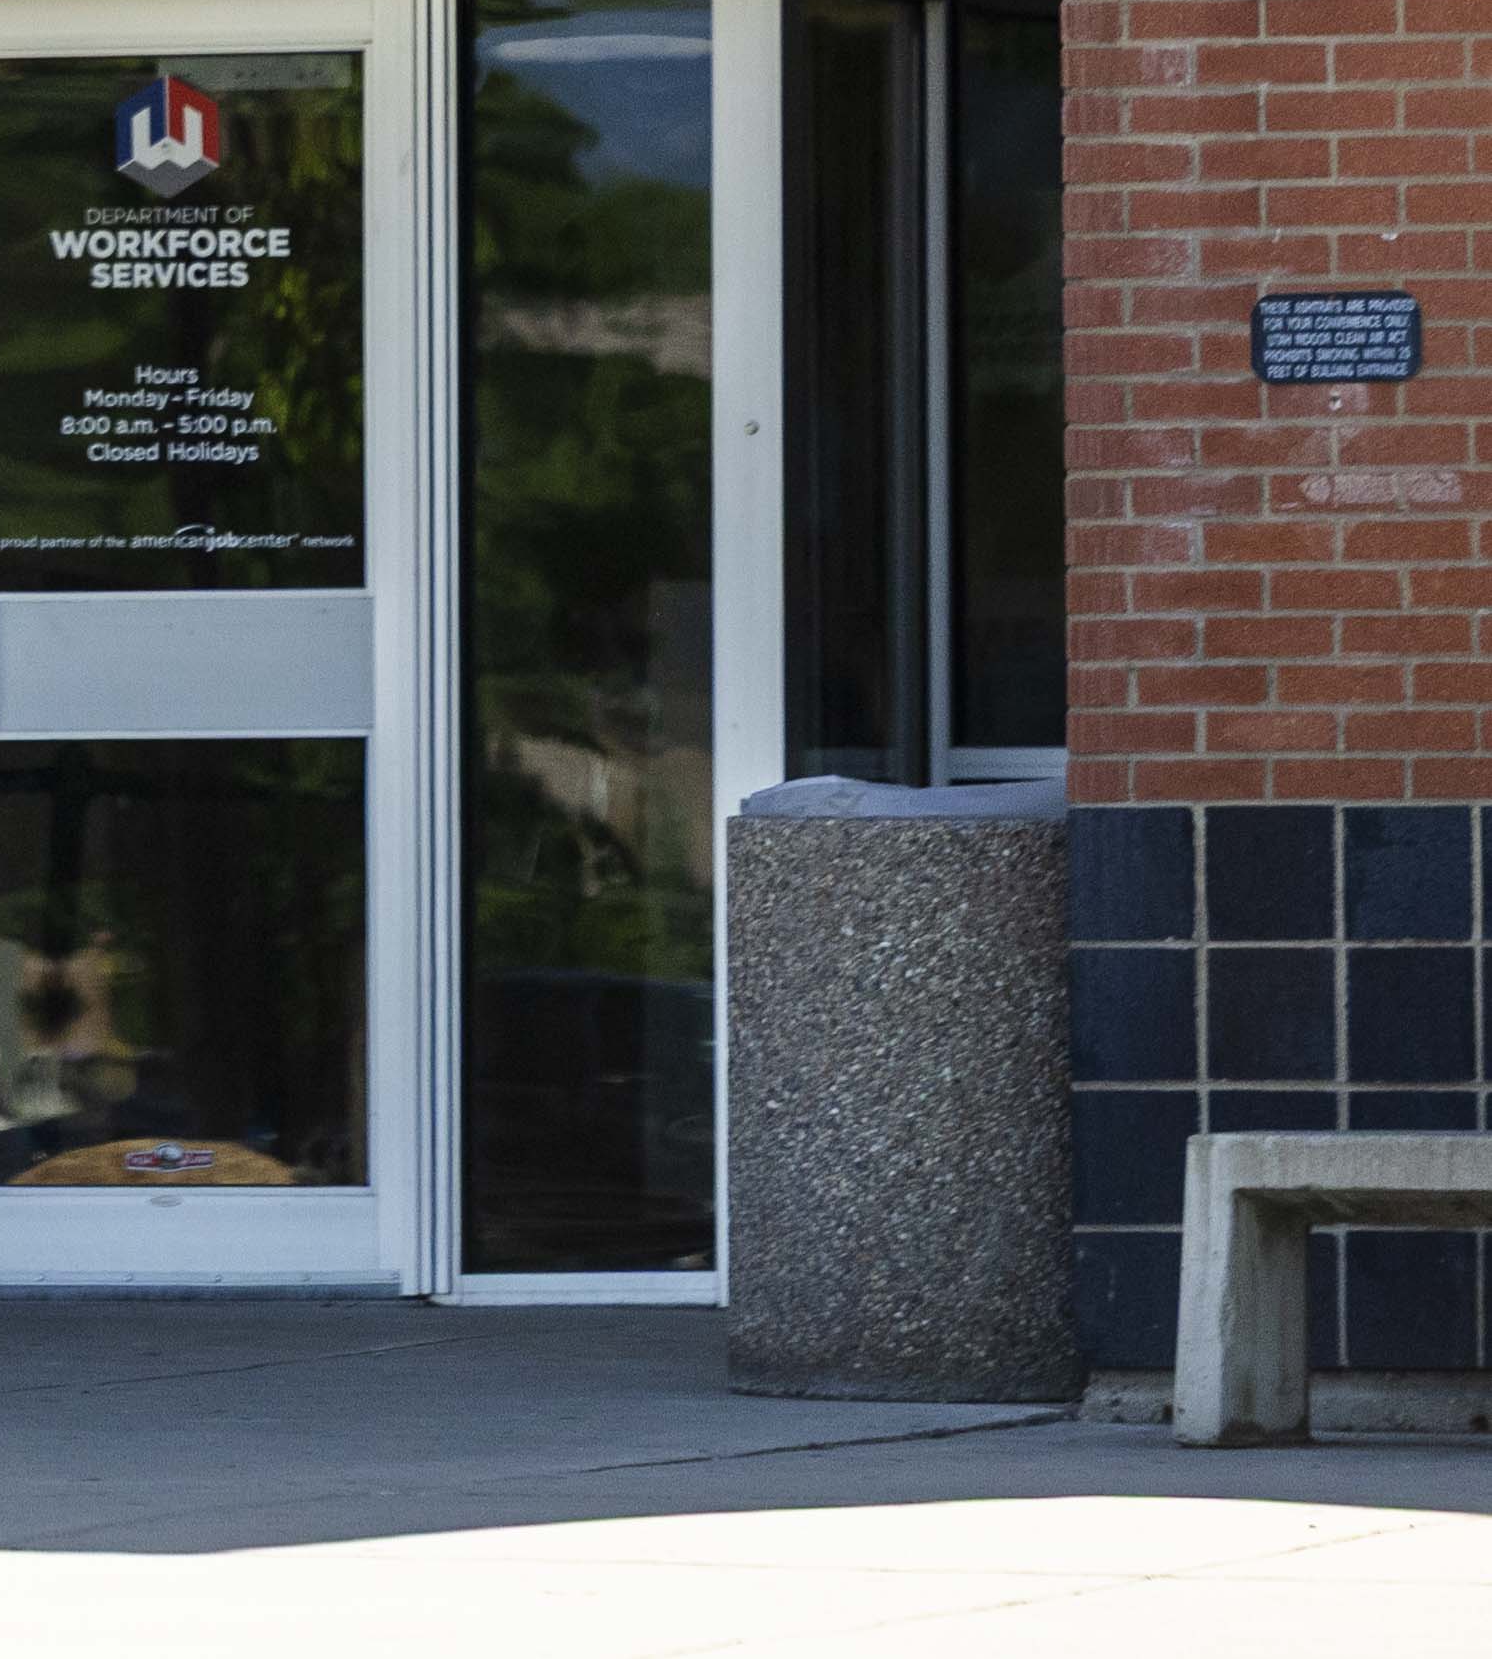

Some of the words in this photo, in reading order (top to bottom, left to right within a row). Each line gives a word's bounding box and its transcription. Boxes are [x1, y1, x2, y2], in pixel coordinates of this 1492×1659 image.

[86, 207, 219, 225] DEPARTMENT
[224, 206, 255, 223] OF
[49, 227, 291, 260] WORKFORCE
[90, 261, 250, 289] SERVICES
[134, 364, 199, 384] Hours
[60, 415, 110, 434] 8:00
[115, 418, 159, 434] a.m.
[177, 414, 227, 434] 5:00
[230, 417, 278, 436] p.m.
[87, 443, 160, 461] Closed
[167, 442, 259, 464] Holidays
[0, 535, 38, 550] proud
[40, 536, 86, 550] partner
[87, 535, 103, 548] of
[105, 535, 126, 548] the
[302, 534, 355, 548] network
